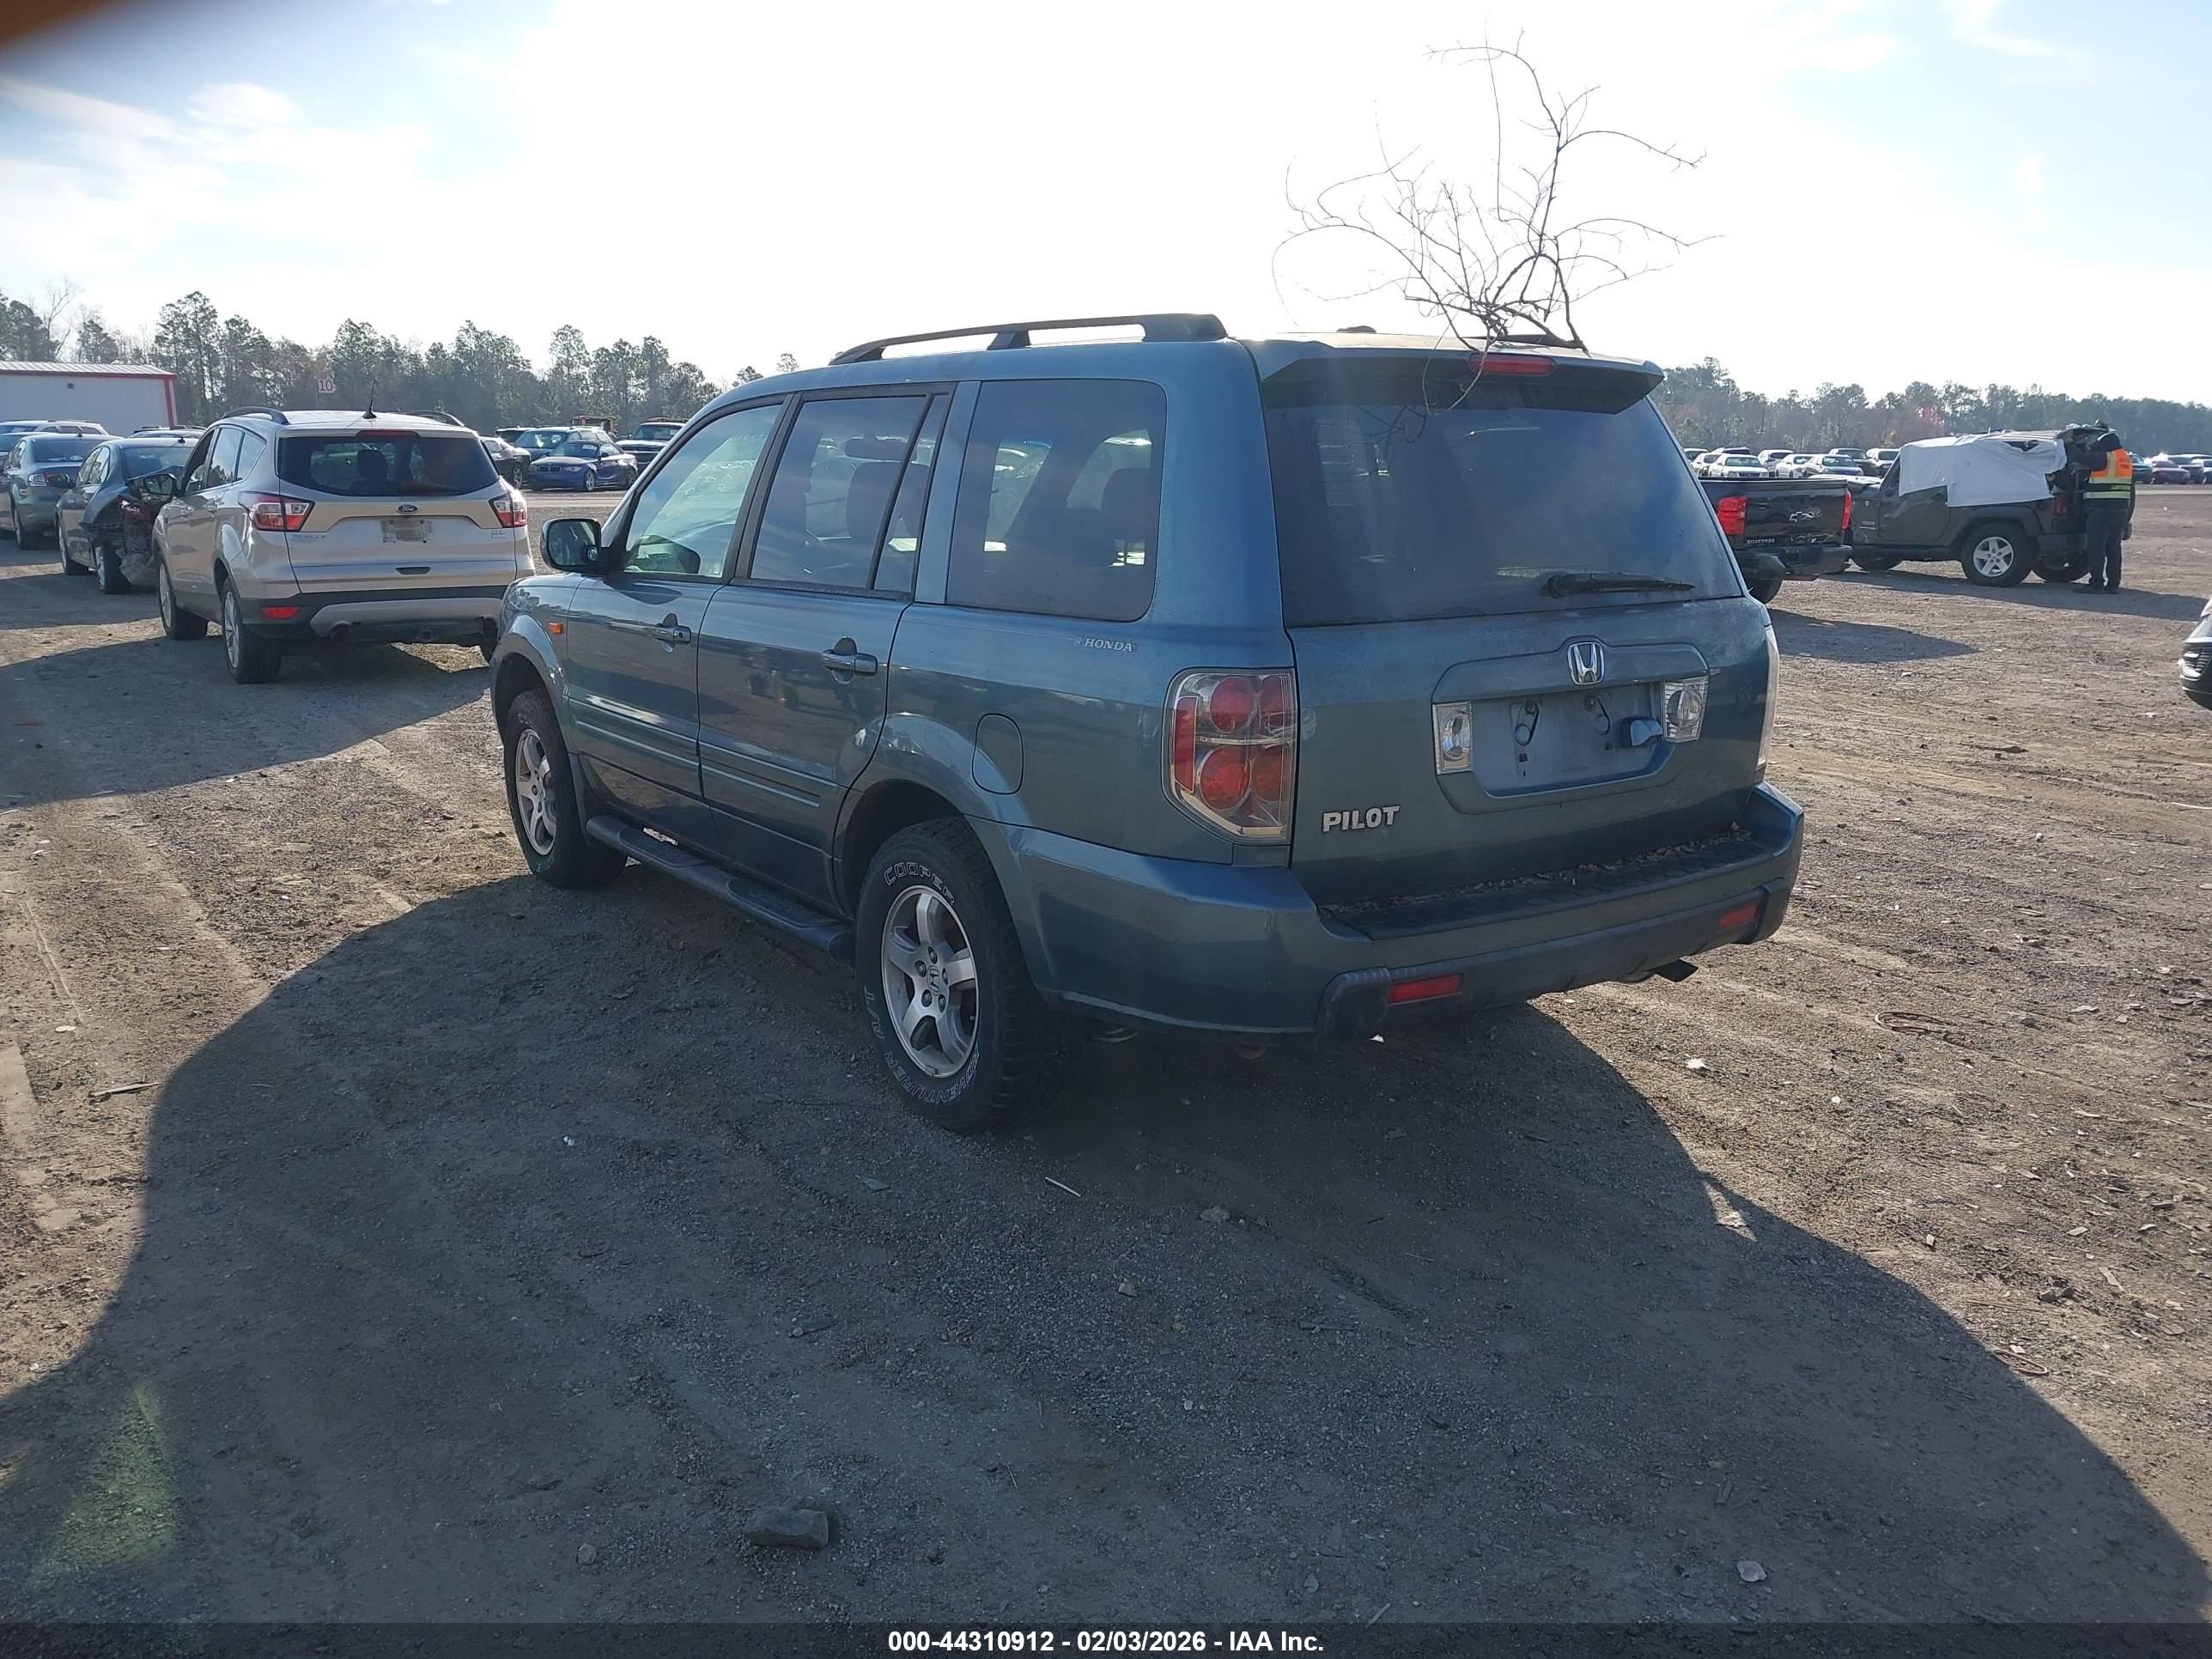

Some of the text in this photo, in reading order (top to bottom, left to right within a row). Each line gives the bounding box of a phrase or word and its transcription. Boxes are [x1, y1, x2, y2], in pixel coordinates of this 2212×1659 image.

[319, 380, 333, 392] 10
[1084, 637, 1133, 653] HONDA
[1322, 805, 1401, 833] PILOT
[884, 861, 956, 908] COOPER
[884, 1042, 981, 1105] ADVENTURER
